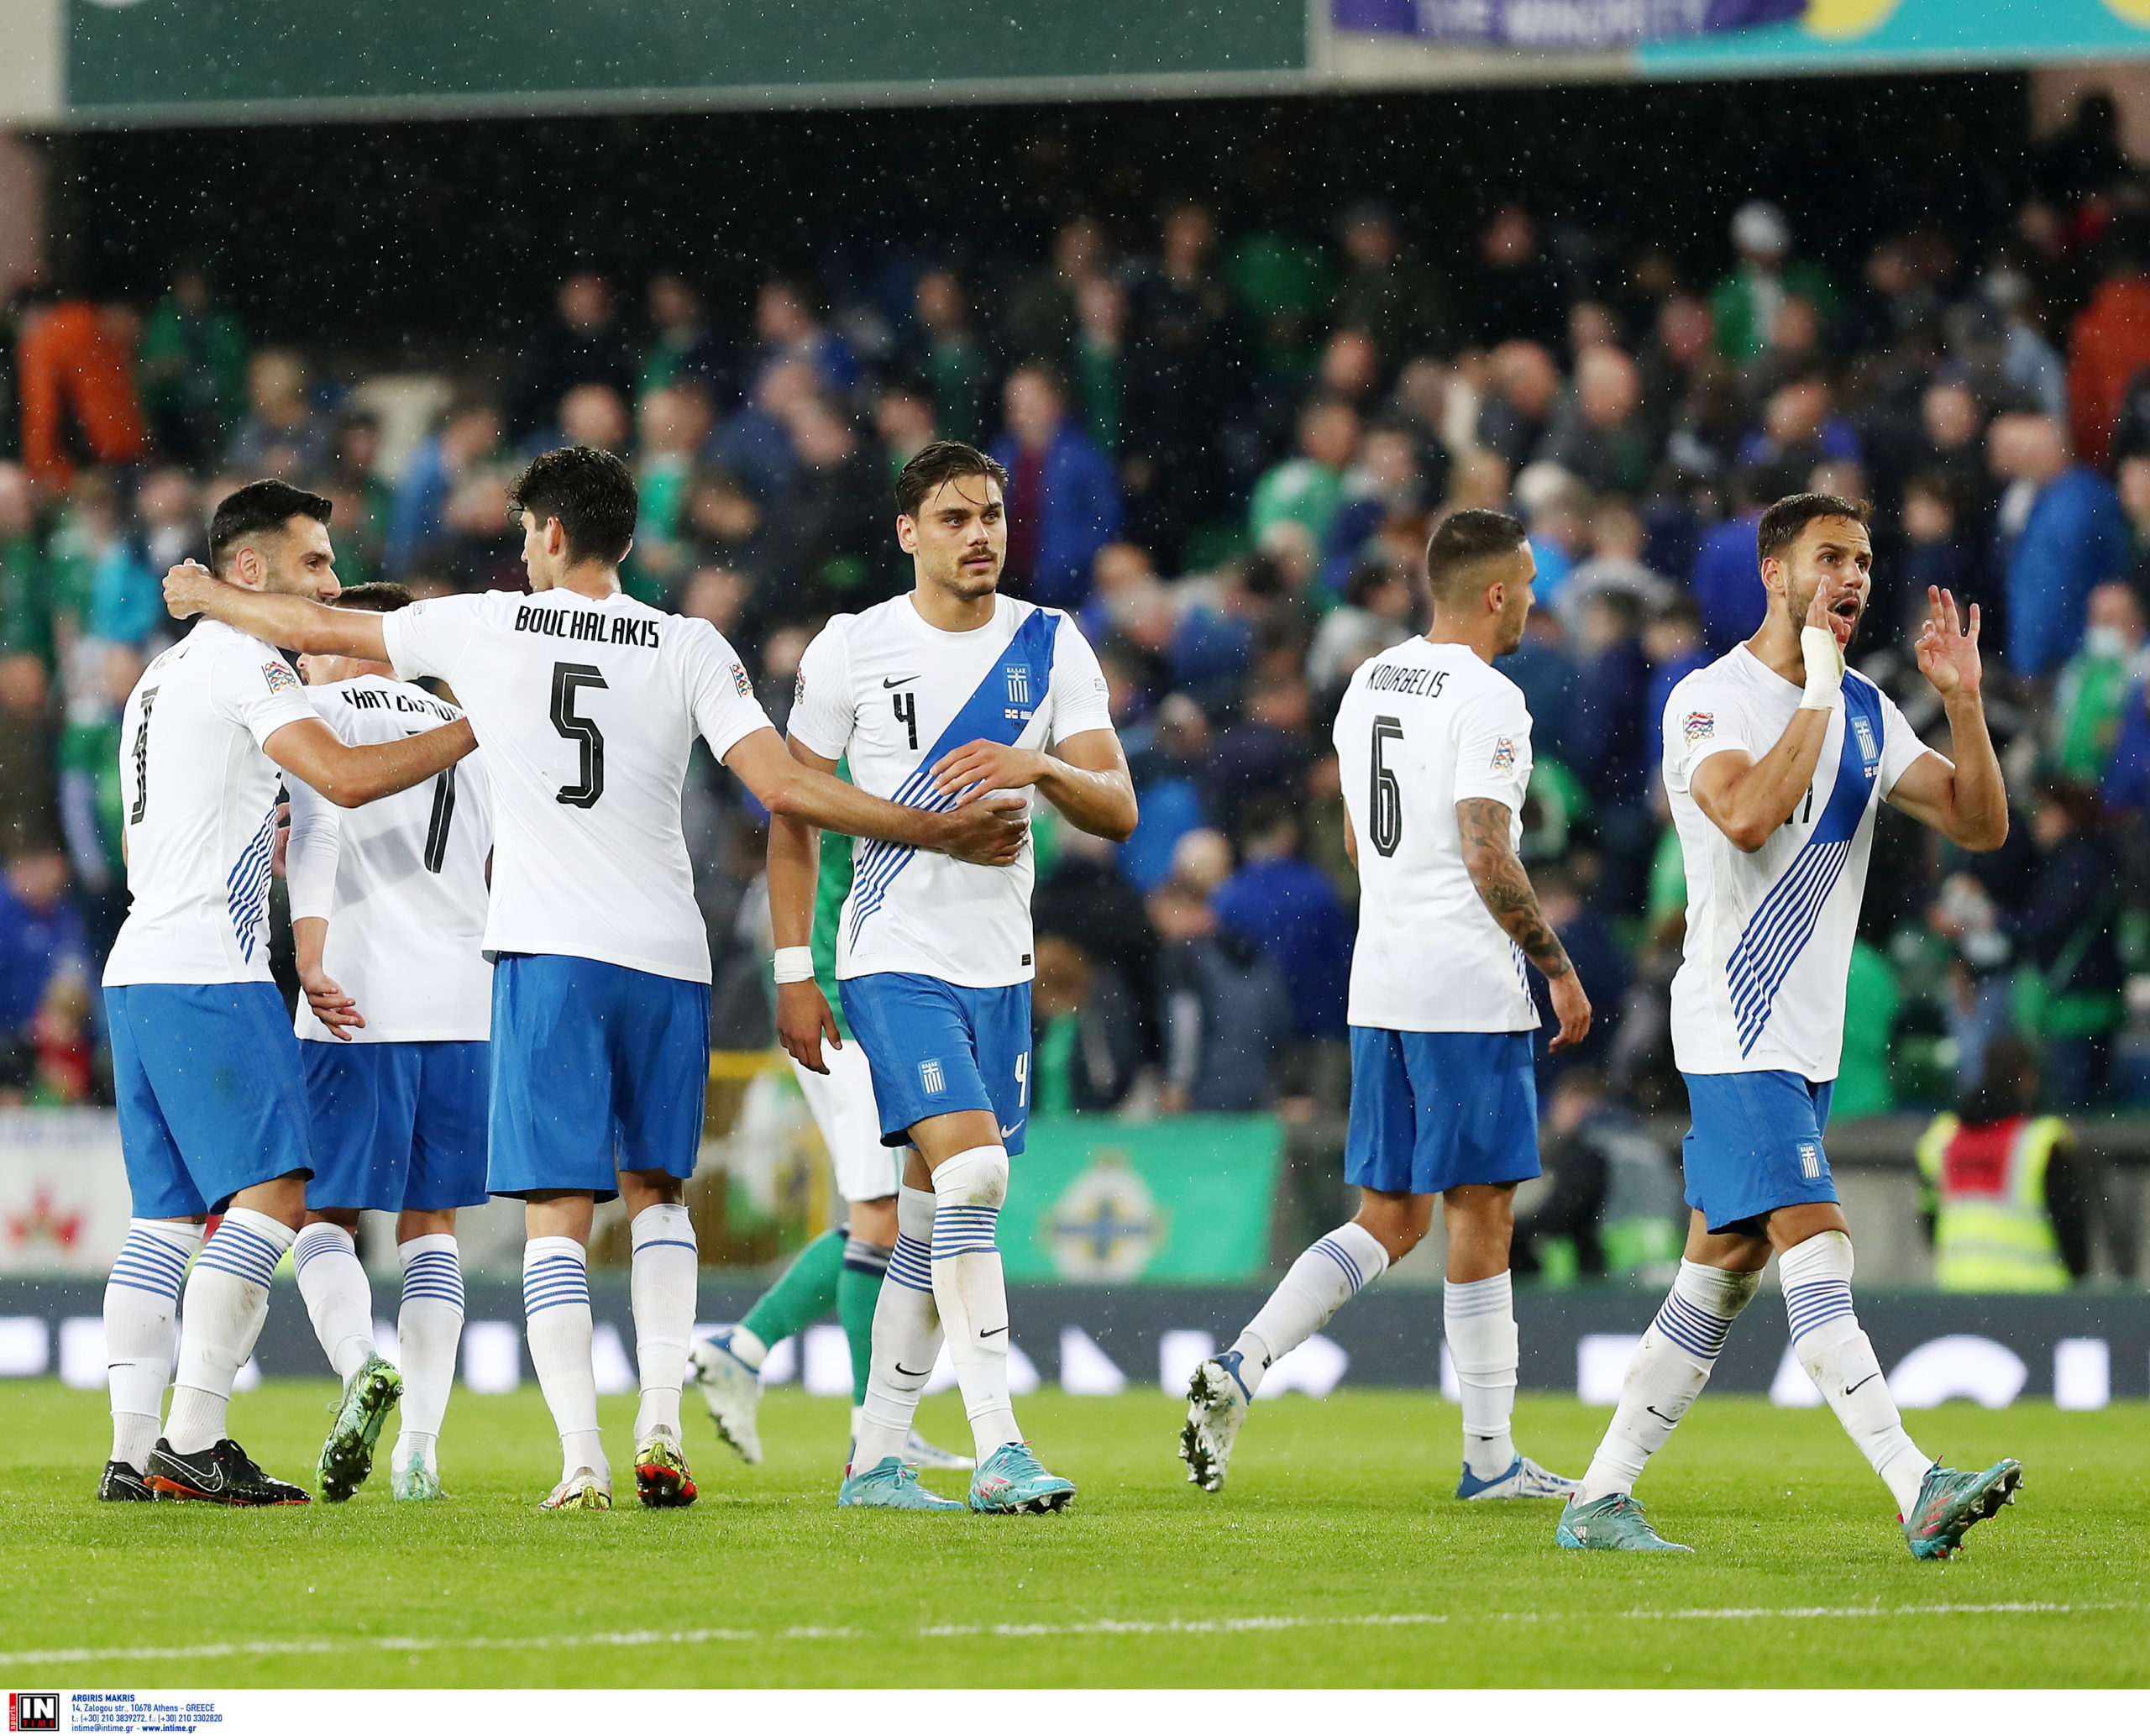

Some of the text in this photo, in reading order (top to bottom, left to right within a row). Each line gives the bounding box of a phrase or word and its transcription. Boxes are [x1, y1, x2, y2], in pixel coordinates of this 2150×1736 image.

[515, 606, 659, 648] BOUCHALAKIS
[1366, 663, 1450, 698] KOURBELIS
[550, 662, 609, 809] 5
[893, 693, 918, 750] 4
[1370, 715, 1404, 858] 6
[1015, 1052, 1028, 1108] 4
